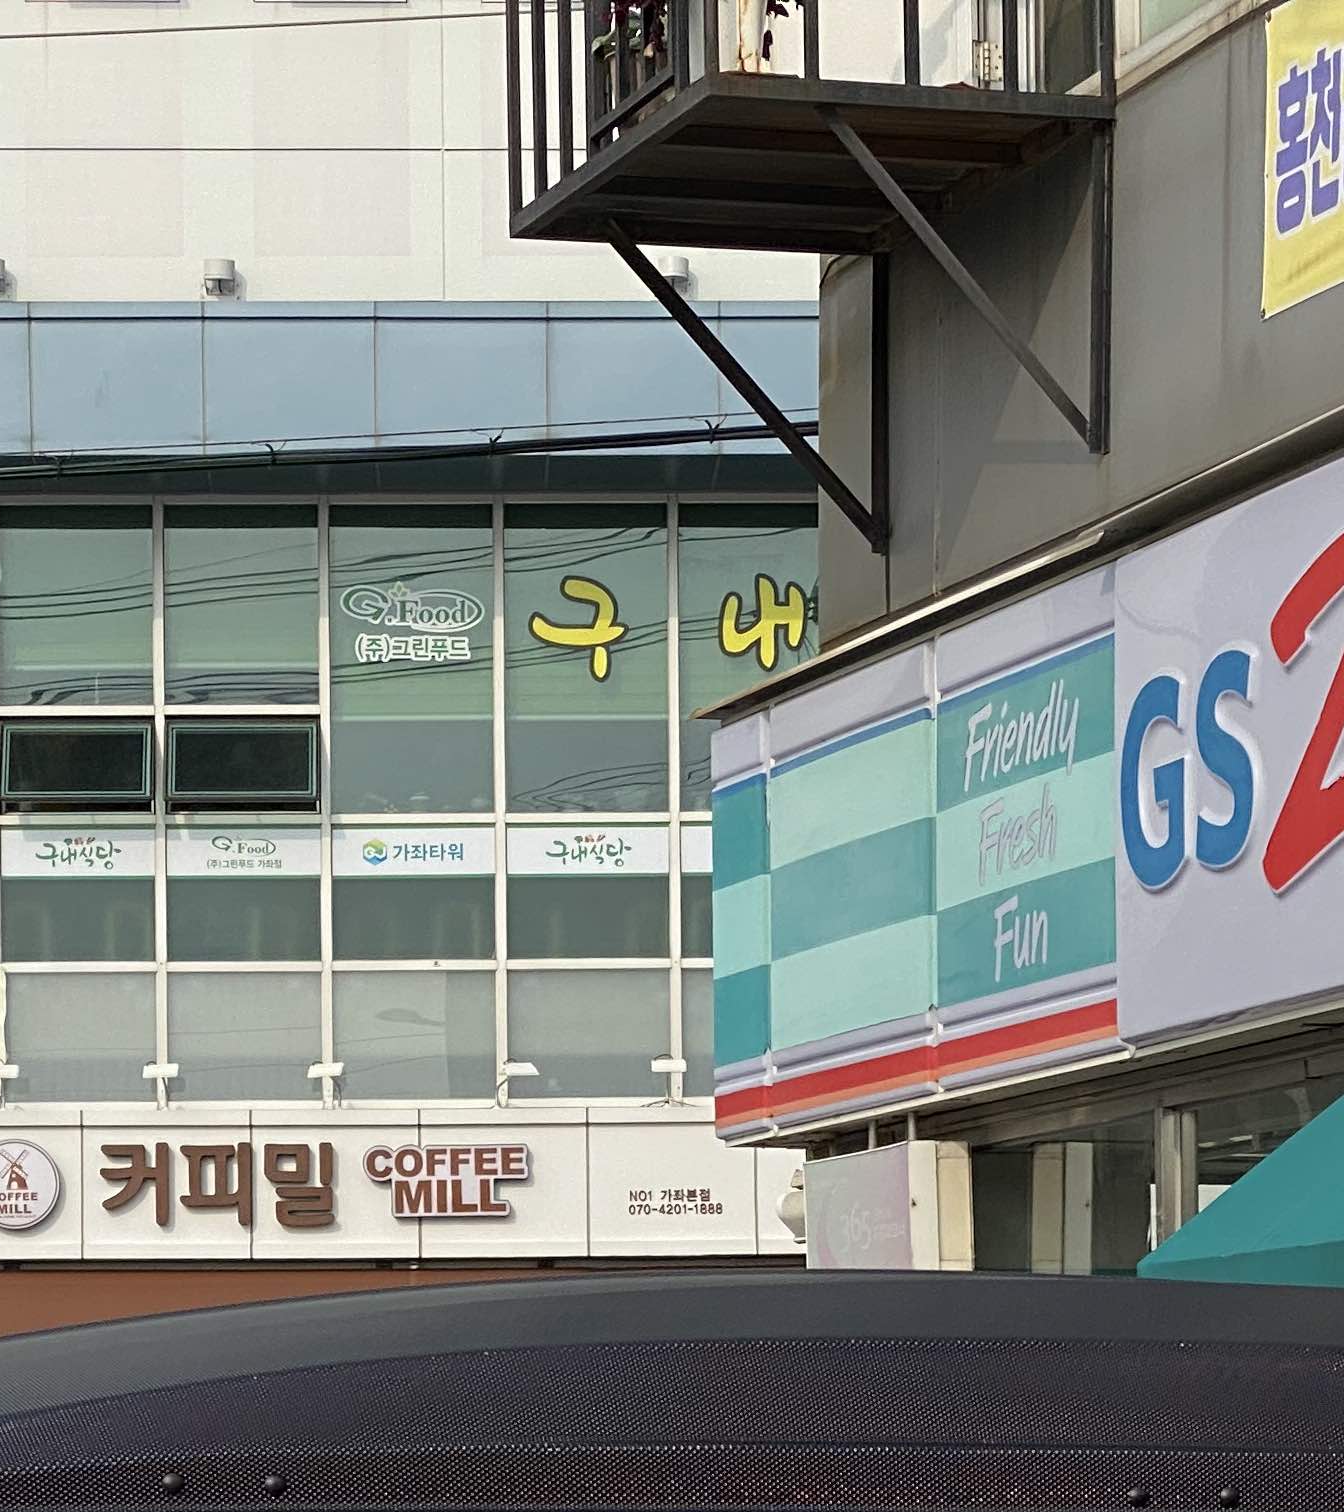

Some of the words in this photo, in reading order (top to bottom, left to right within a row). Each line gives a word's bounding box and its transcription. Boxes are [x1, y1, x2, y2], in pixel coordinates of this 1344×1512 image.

[355, 635, 473, 662] (주)그린푸드
[963, 678, 1081, 792] Friendly
[978, 781, 1058, 888] Fresh
[35, 840, 123, 871] 구내식당
[391, 842, 465, 862] 가좌타워
[545, 837, 633, 868] 구내식당
[993, 894, 1049, 983] Fun
[364, 1145, 528, 1179] COFFEE
[99, 1141, 338, 1228] 커피밀
[393, 1179, 509, 1215] MILL
[628, 1189, 653, 1202] NO1
[660, 1188, 711, 1202] 가좌본점
[628, 1203, 724, 1215] 070-4201-1888
